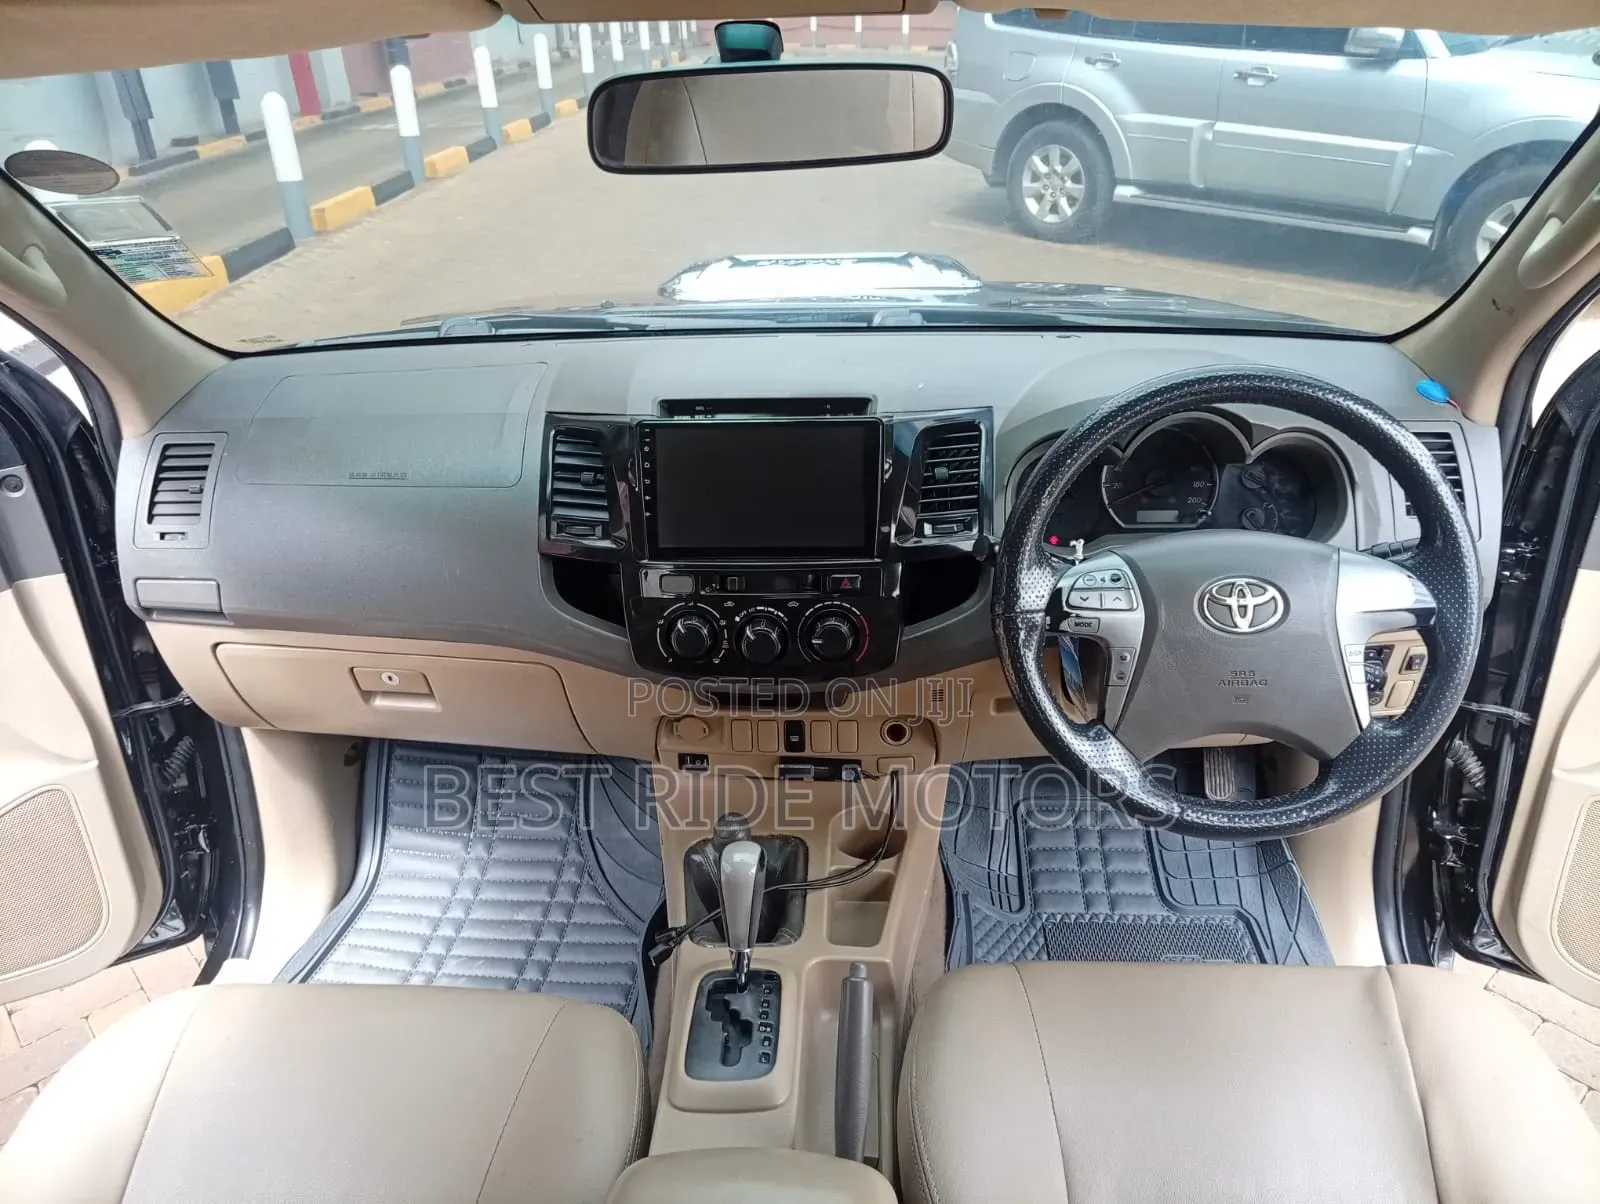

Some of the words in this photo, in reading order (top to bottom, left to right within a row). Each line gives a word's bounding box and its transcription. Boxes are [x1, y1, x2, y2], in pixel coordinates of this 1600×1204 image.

[1187, 496, 1202, 504] 200
[1230, 670, 1256, 679] SRS
[1217, 679, 1268, 687] AIRBAG
